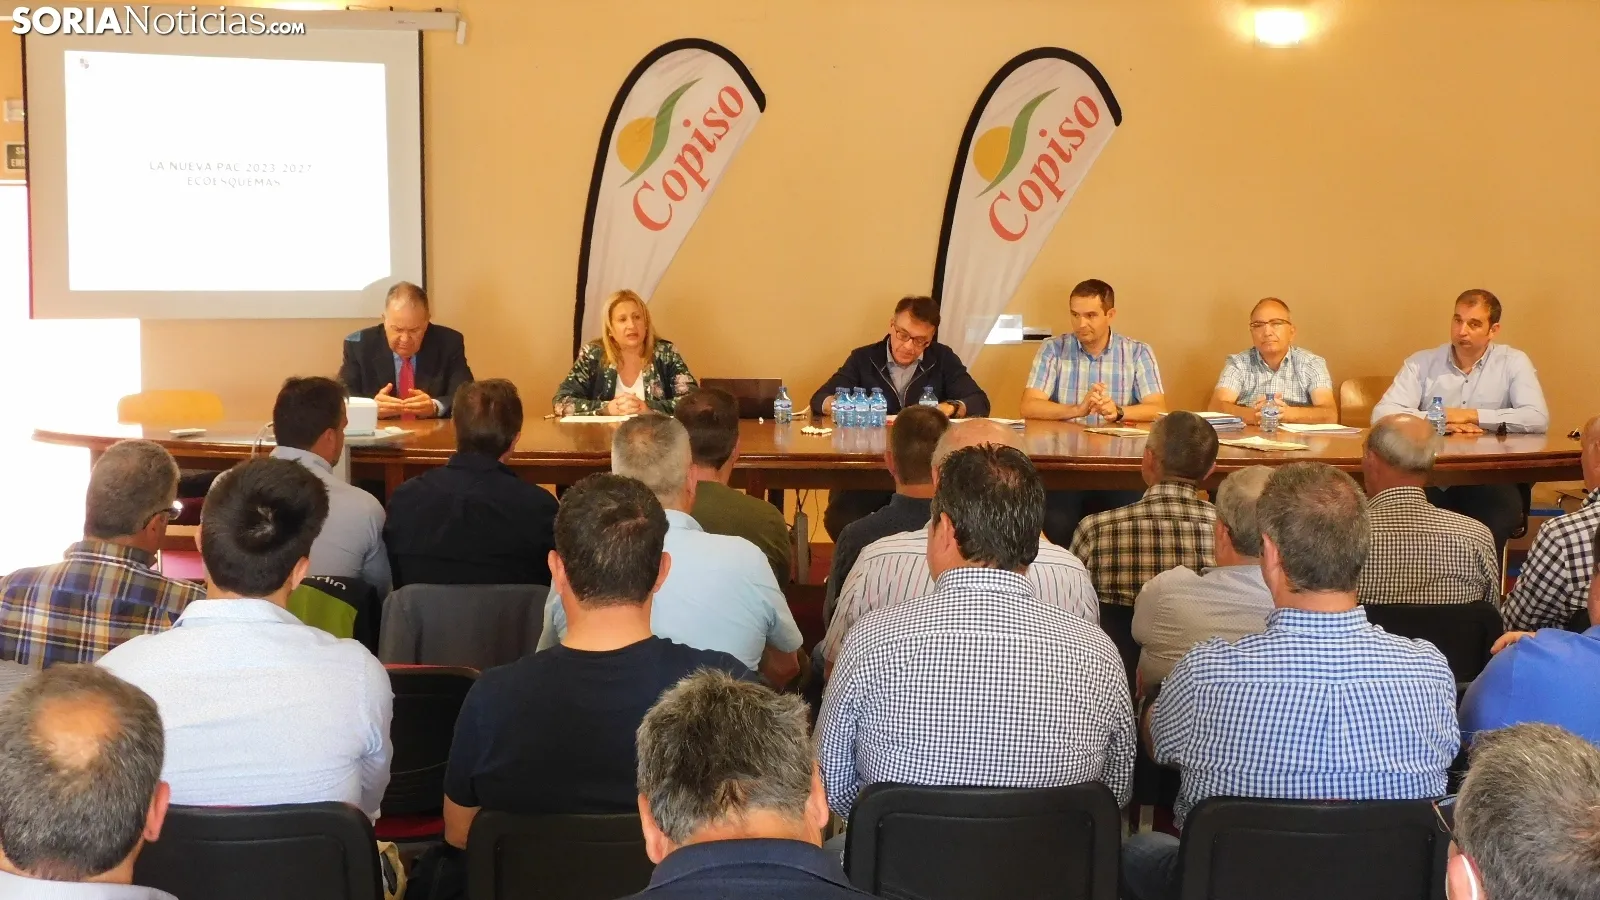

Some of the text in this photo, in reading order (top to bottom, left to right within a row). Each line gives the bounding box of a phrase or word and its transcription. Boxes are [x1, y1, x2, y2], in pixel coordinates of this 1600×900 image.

[149, 161, 165, 171] LA
[169, 161, 212, 172] NUEVA
[216, 162, 242, 172] PAC
[632, 85, 744, 232] Copiso
[988, 95, 1100, 242] Copiso
